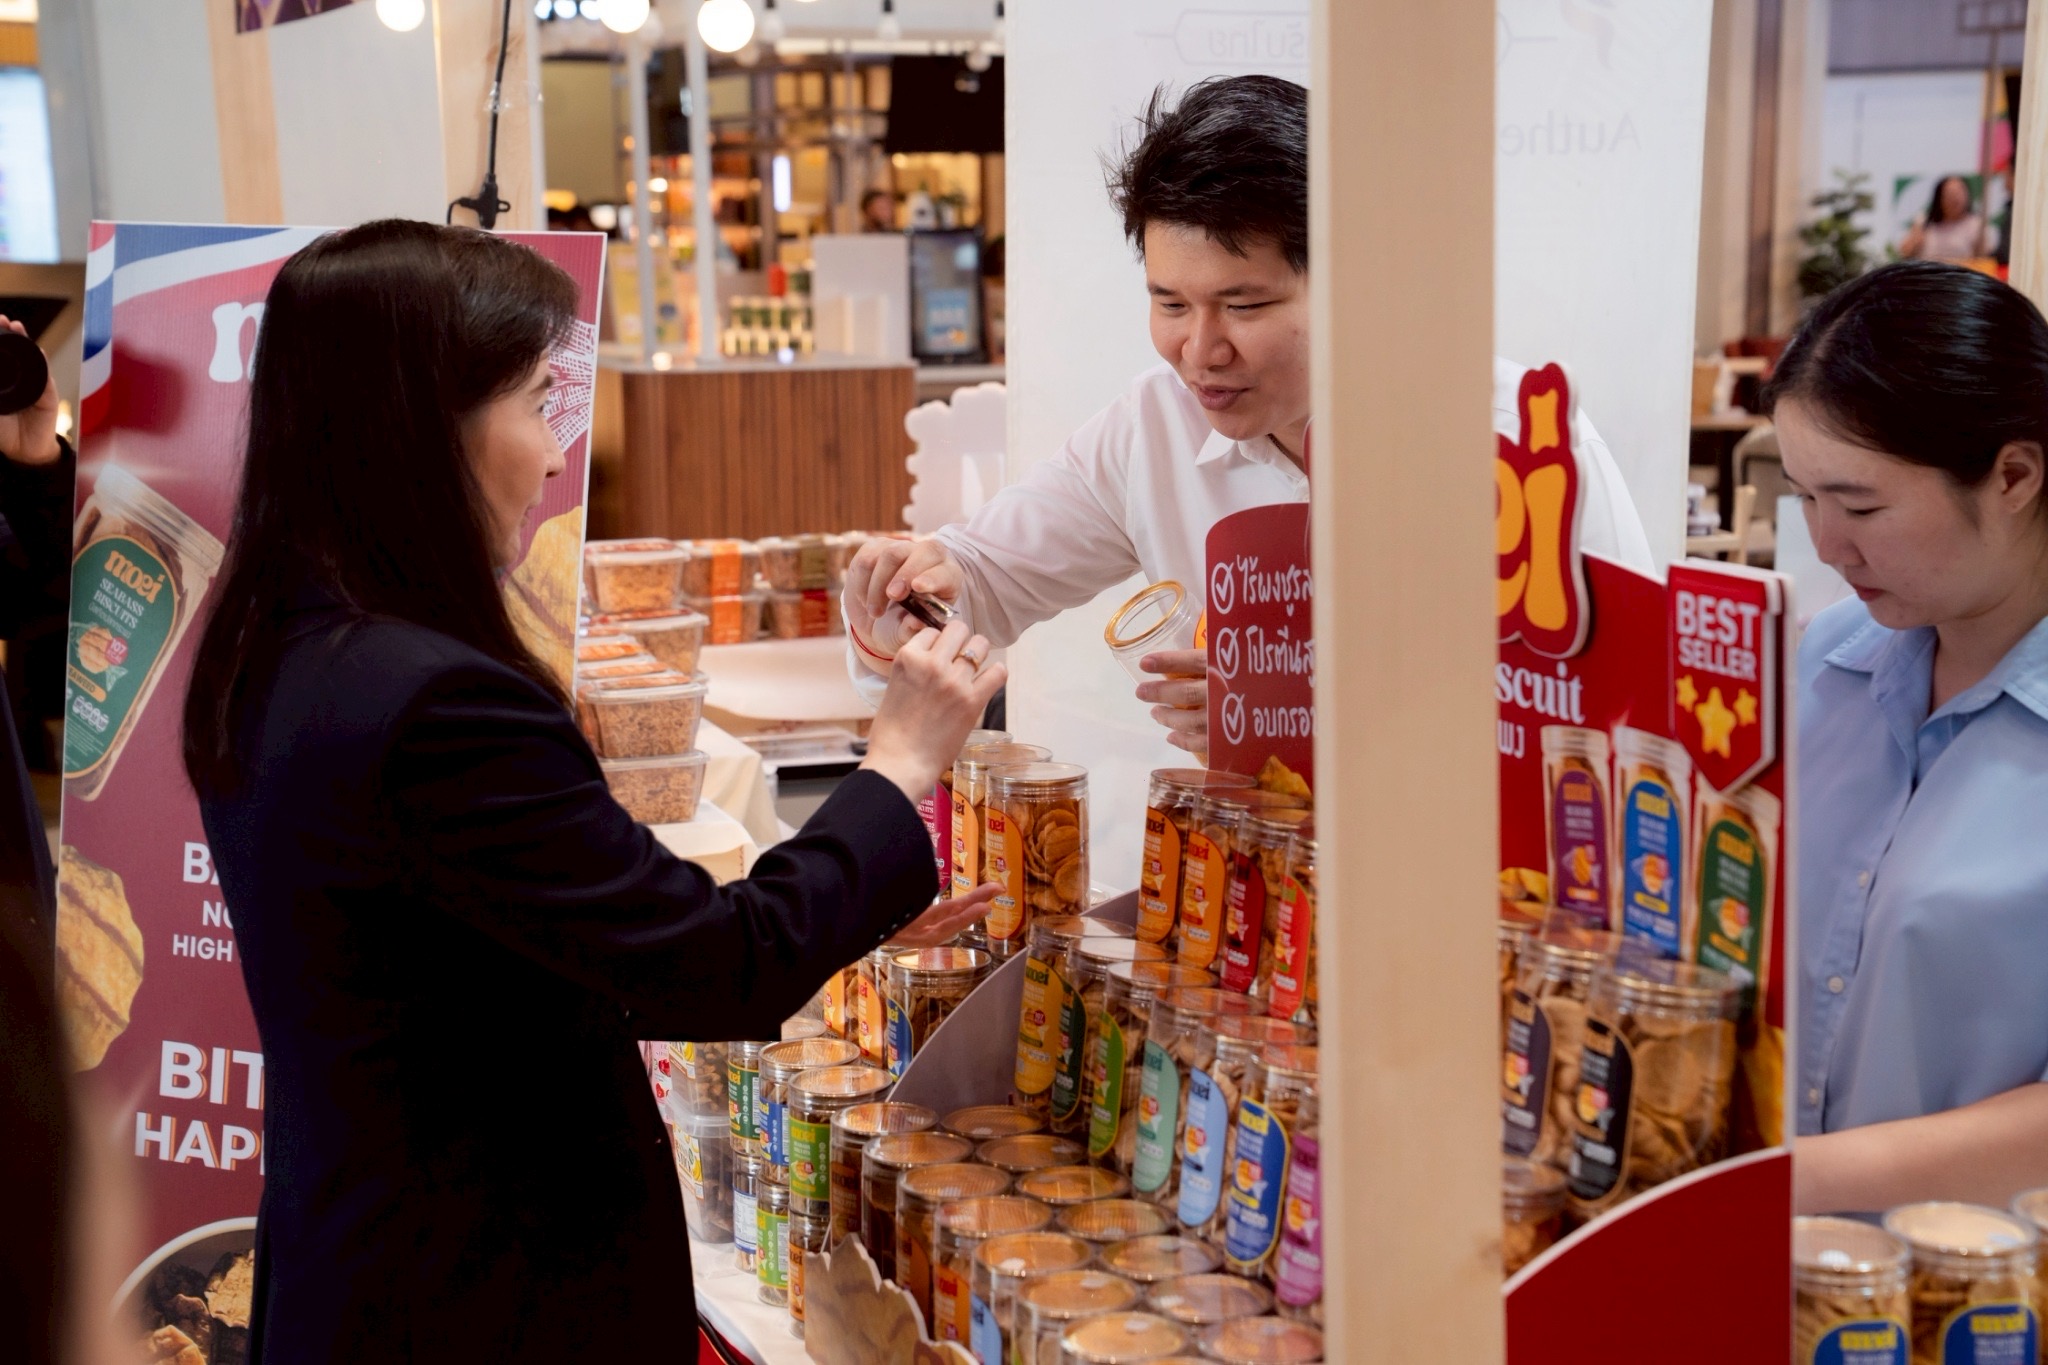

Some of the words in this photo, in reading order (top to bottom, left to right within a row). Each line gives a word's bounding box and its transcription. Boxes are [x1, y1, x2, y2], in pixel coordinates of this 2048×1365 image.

[93, 589, 139, 630] BISCUITS
[99, 577, 145, 618] SEABASS
[1675, 589, 1761, 650] BEST
[1677, 634, 1758, 683] SELLER
[1494, 660, 1586, 726] scuit
[172, 933, 233, 962] HIGH
